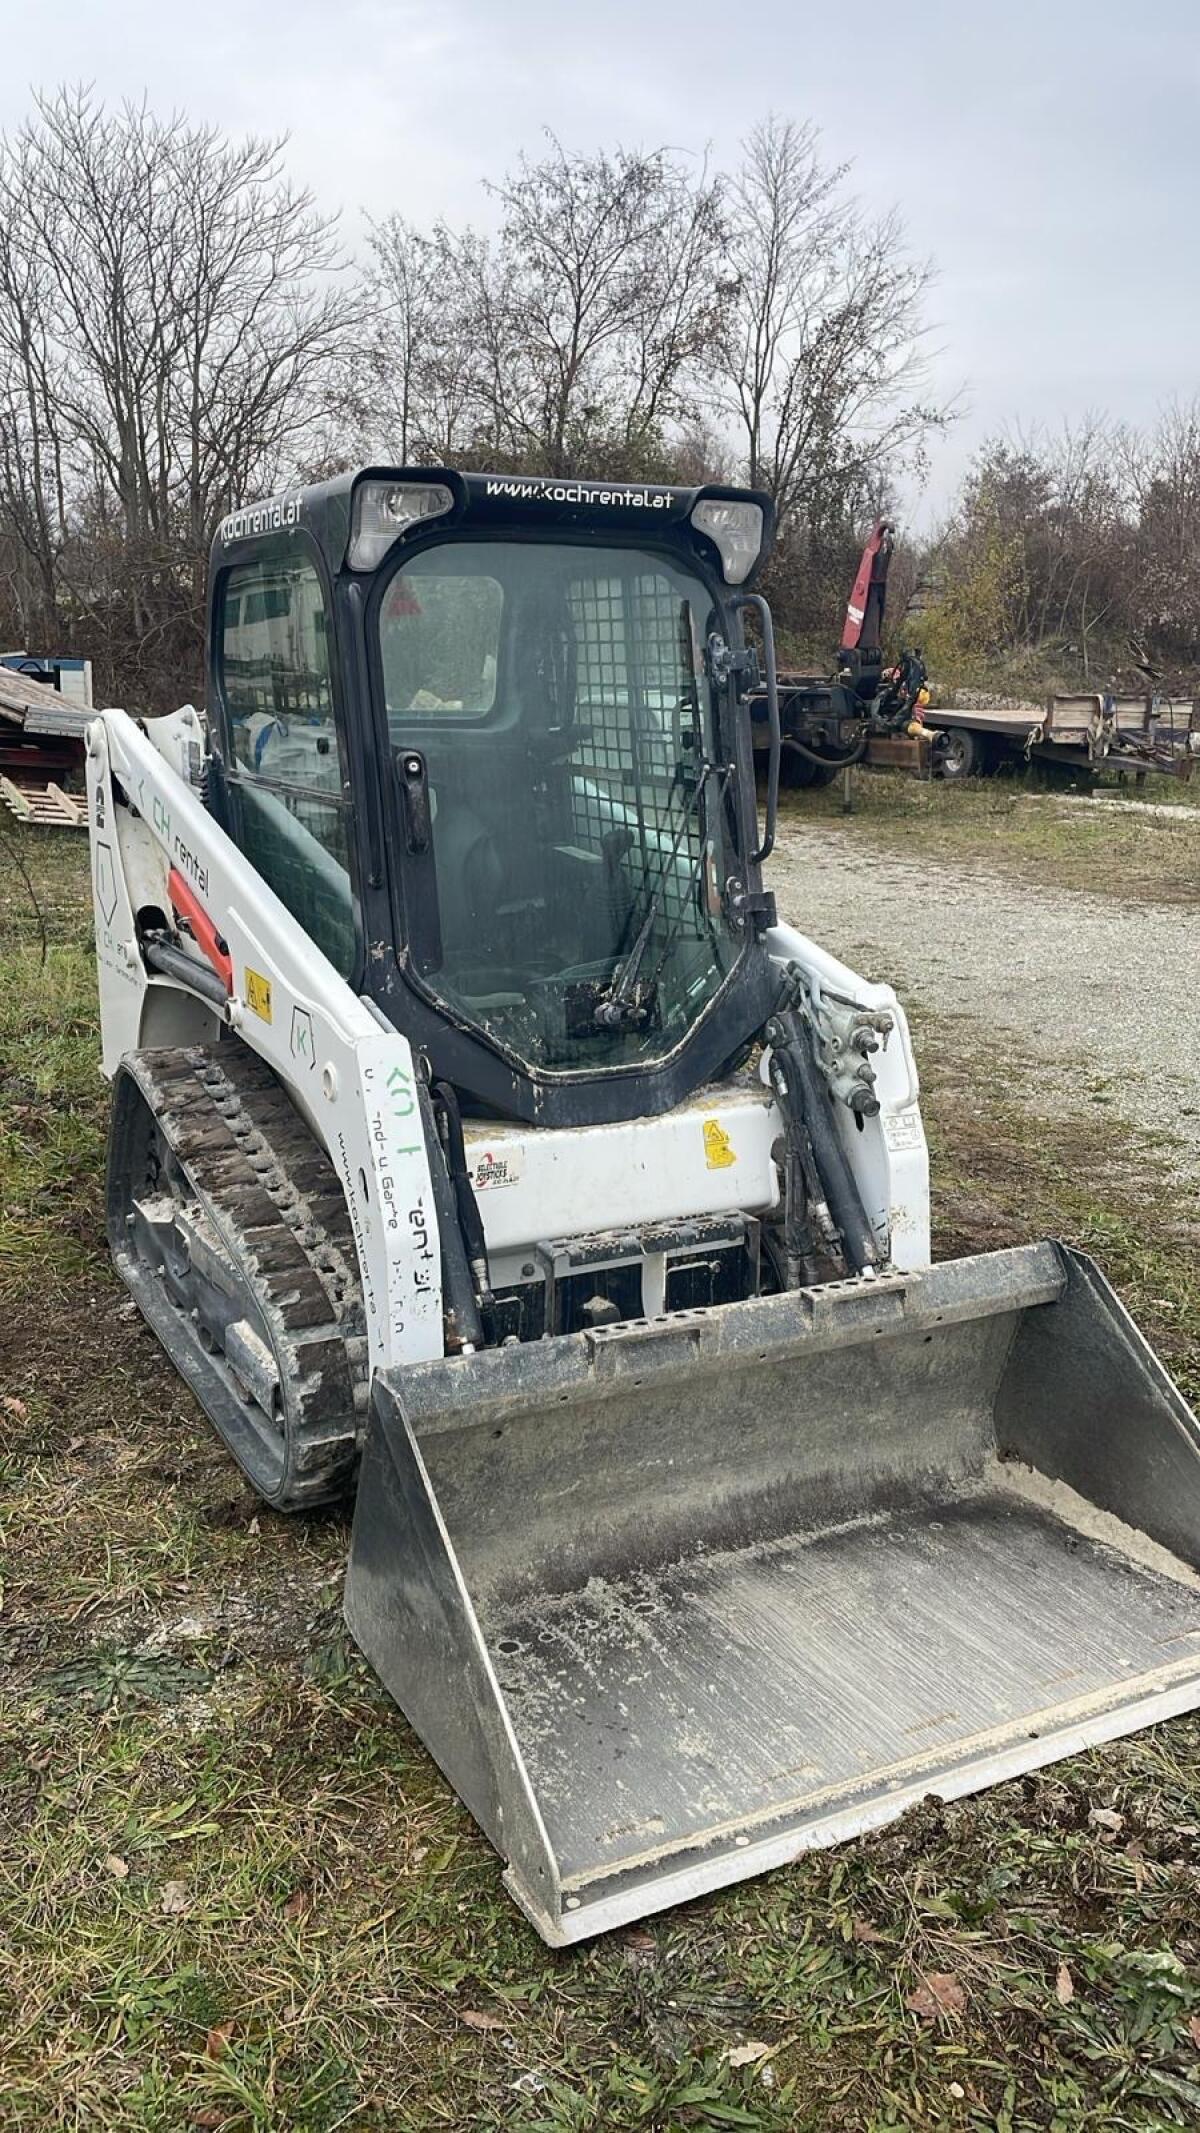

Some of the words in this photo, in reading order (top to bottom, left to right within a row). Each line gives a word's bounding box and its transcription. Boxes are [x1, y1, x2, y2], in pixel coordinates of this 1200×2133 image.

[221, 494, 303, 541] kochrental.at
[486, 481, 675, 510] www.kochrental.at
[174, 834, 209, 899] rental
